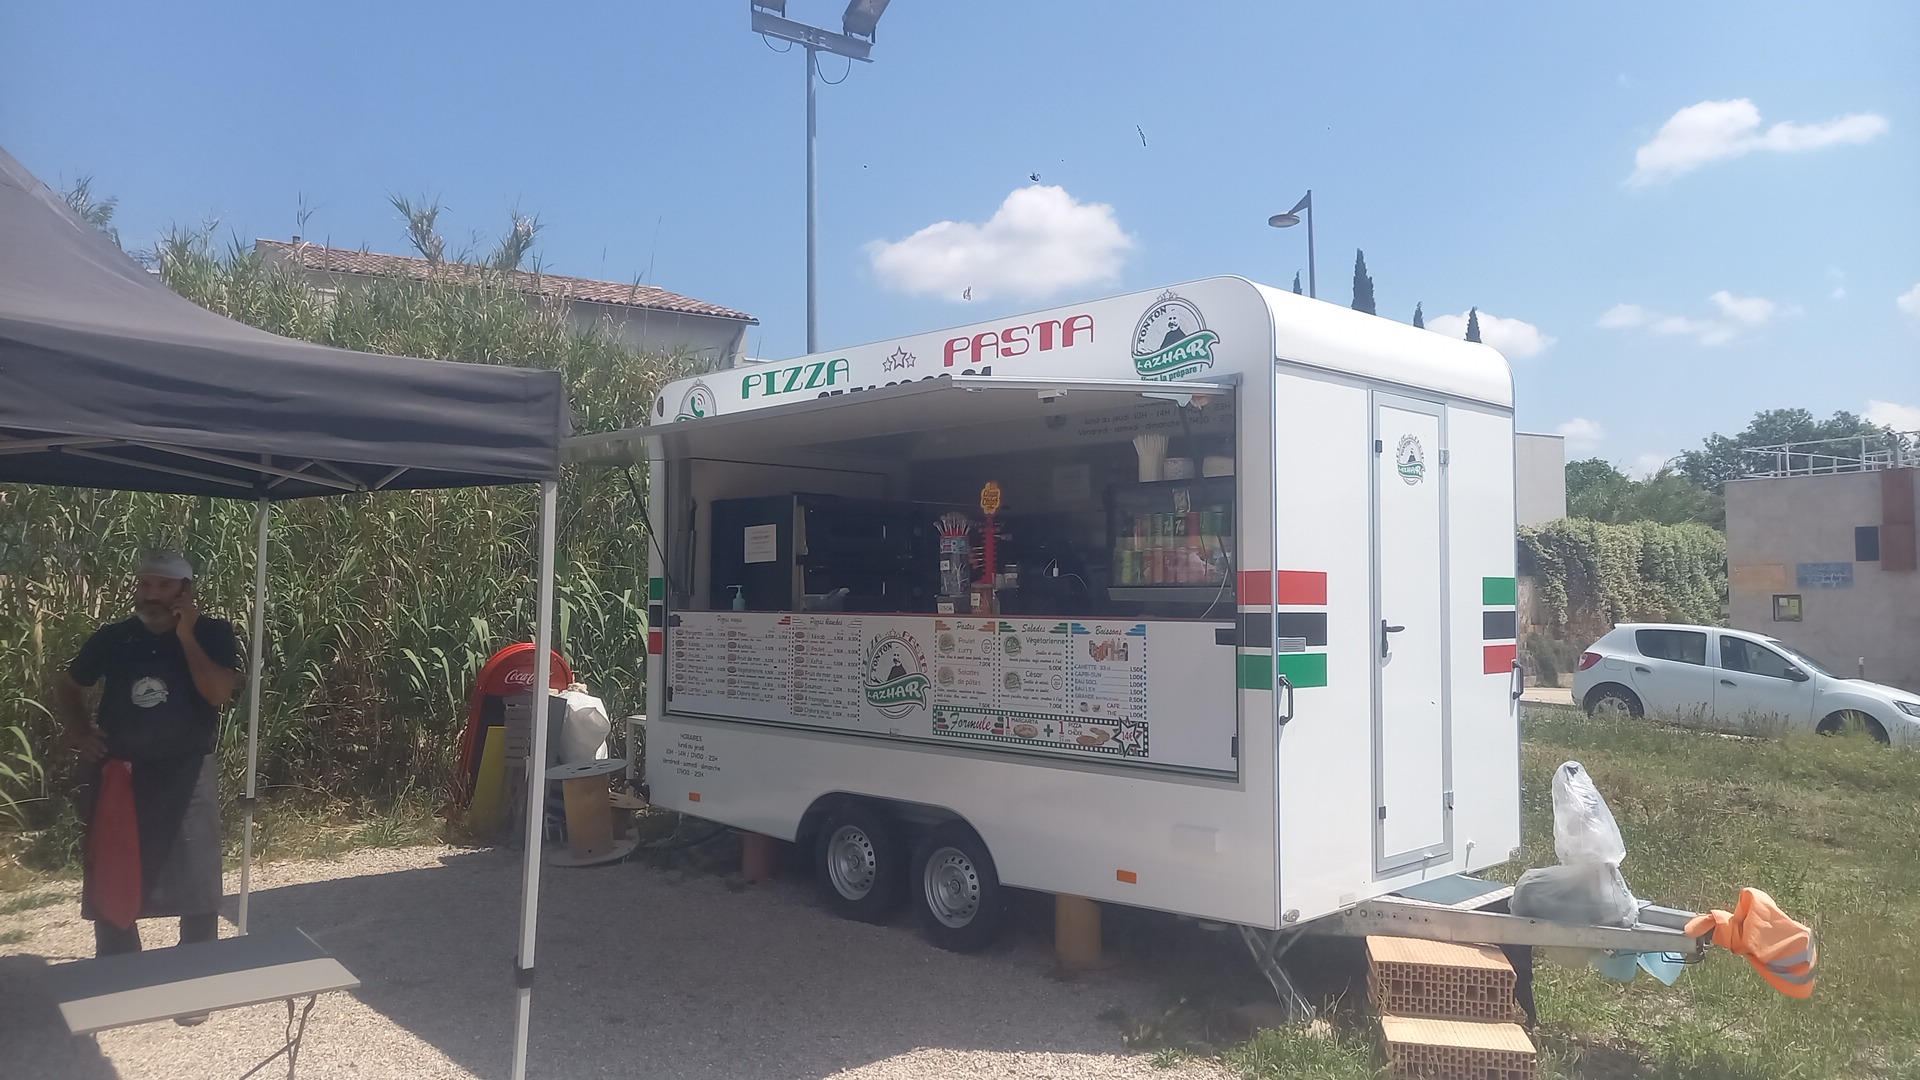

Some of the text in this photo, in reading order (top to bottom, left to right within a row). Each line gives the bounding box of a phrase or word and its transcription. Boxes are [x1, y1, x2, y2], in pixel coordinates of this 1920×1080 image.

[1138, 305, 1167, 345] TONTON
[943, 314, 1094, 368] PASTA
[1137, 338, 1208, 369] LAZHAR
[741, 358, 849, 400] PIZZA
[1084, 416, 1100, 425] lundi
[1156, 408, 1171, 417] 14H
[1145, 419, 1180, 430] dimanche
[1021, 623, 1046, 633] Salades
[1095, 625, 1122, 635] Boissons
[958, 637, 976, 645] Poulet
[1025, 636, 1066, 647] Végétarienne
[871, 642, 893, 673] TONTON
[1025, 670, 1043, 678] César
[867, 681, 922, 700] LAZHAR
[949, 711, 992, 731] Formule
[1067, 722, 1082, 730] PIZZA
